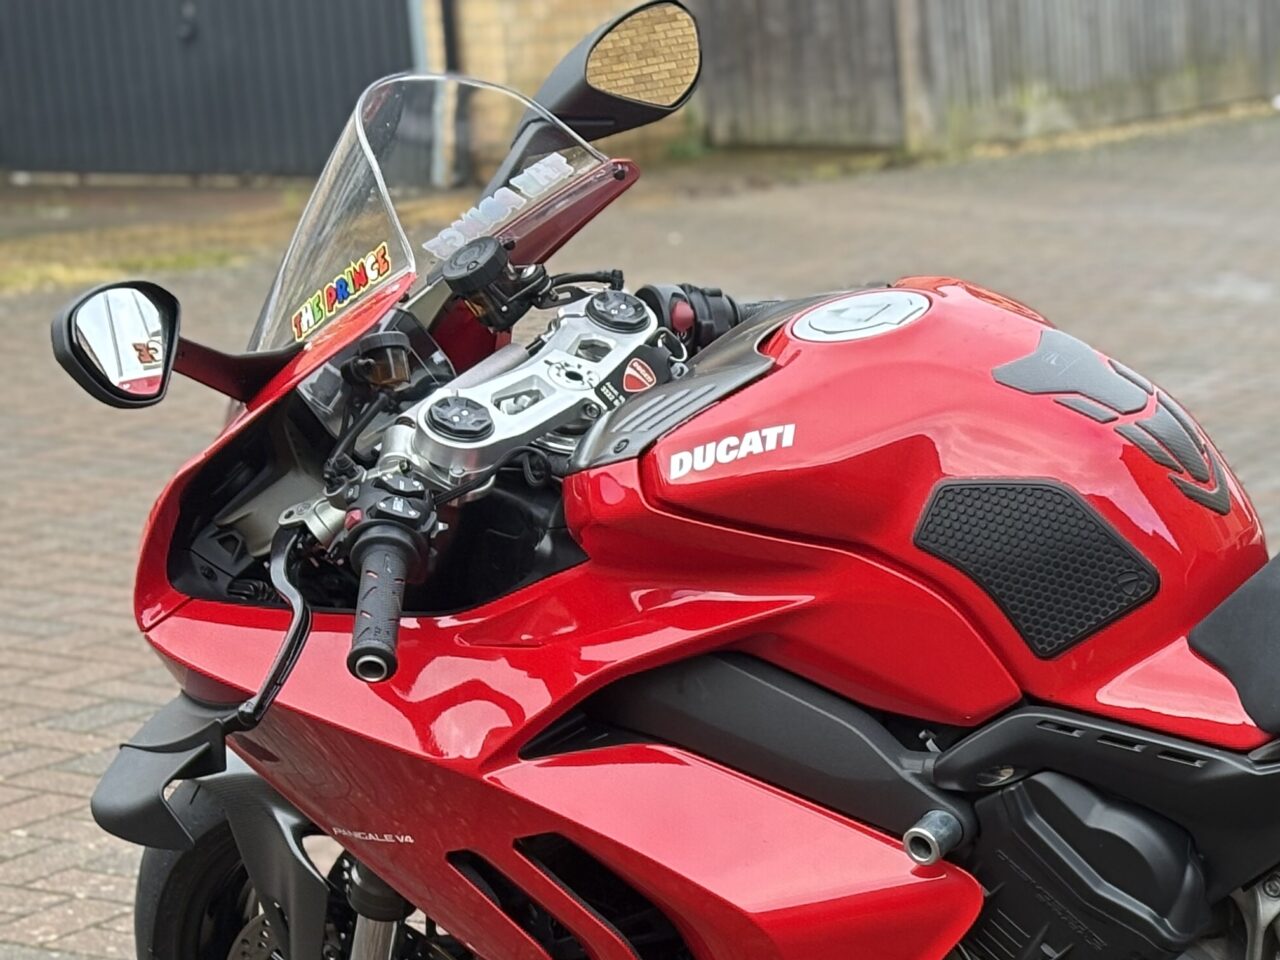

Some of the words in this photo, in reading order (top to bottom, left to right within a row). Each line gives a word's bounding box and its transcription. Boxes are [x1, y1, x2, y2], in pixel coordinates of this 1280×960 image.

[291, 289, 325, 342] THE
[323, 241, 392, 317] PRINCE
[669, 423, 796, 480] DUCATI
